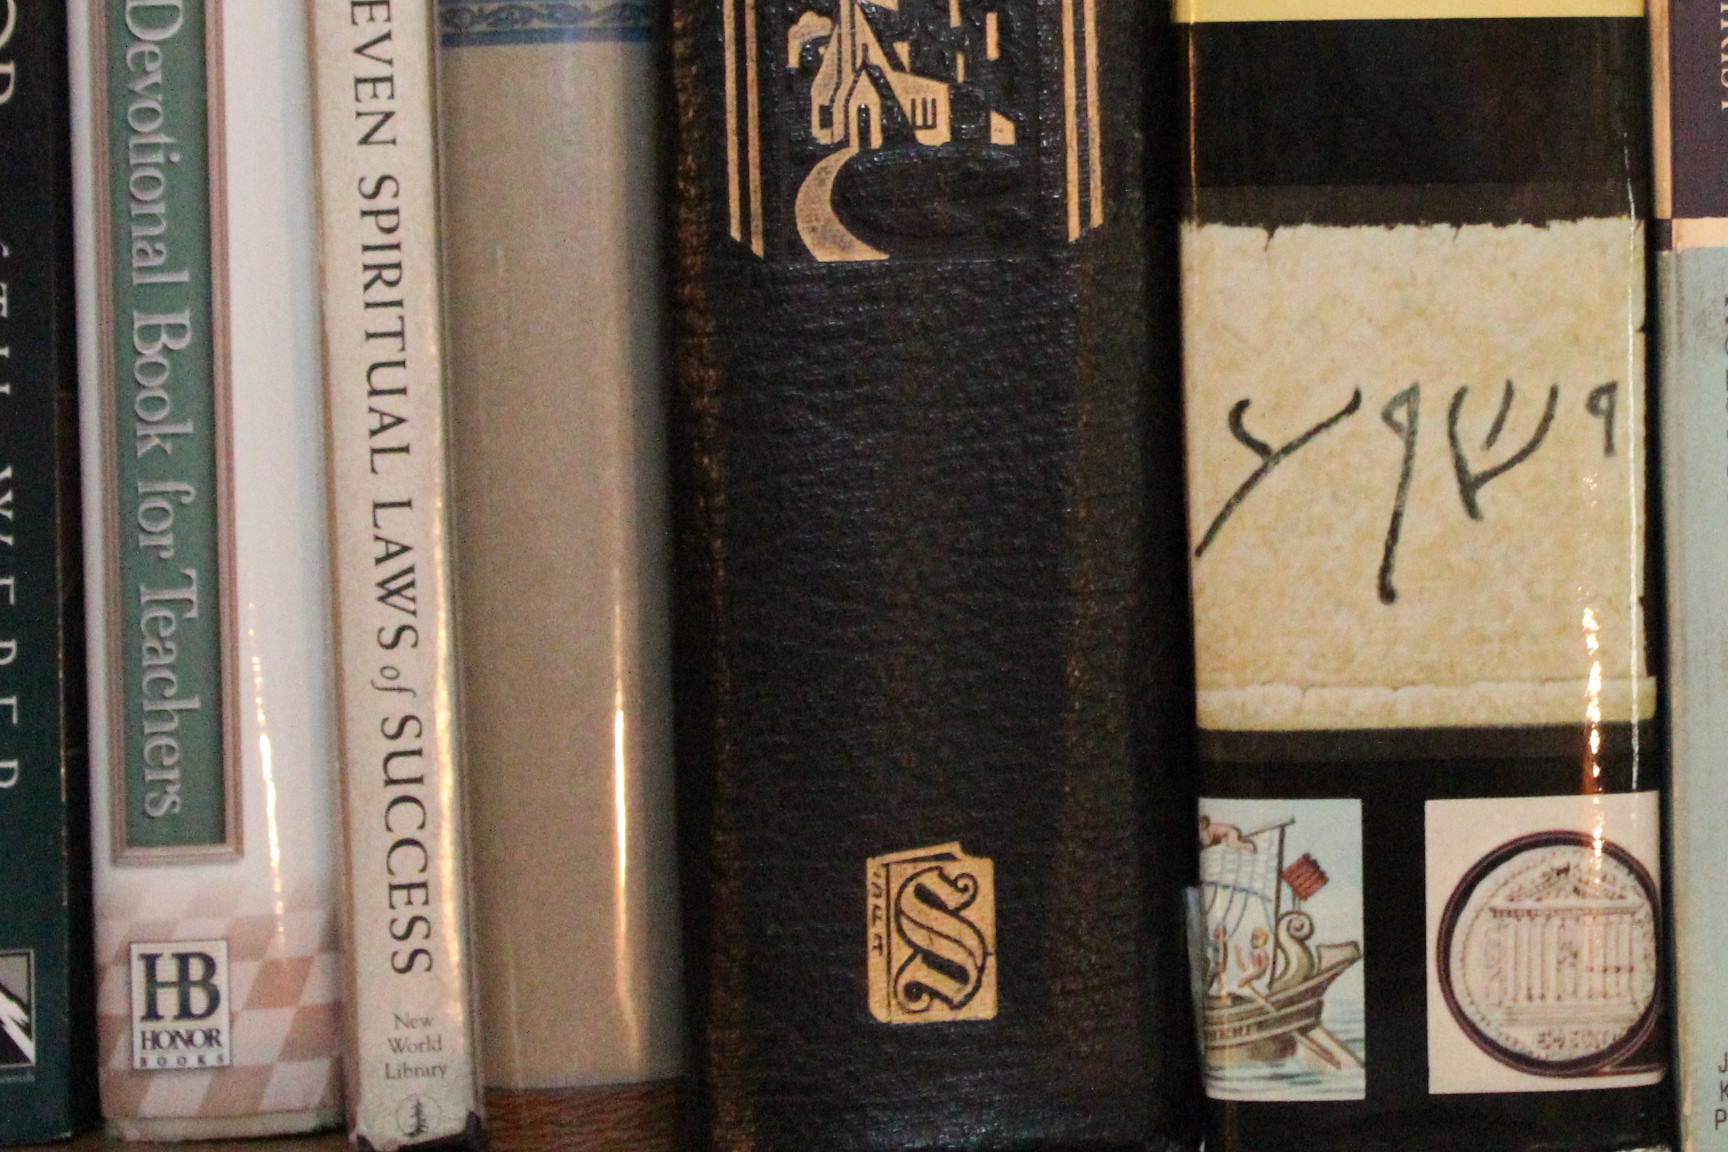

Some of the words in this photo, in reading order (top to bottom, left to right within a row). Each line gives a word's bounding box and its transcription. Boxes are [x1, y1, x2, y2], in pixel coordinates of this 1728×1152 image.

[358, 173, 411, 475] SPIRITUAL
[133, 309, 194, 456] Book
[137, 482, 196, 557] for
[371, 497, 420, 650] LAWS
[138, 570, 200, 818] Teachers
[370, 666, 410, 699] of
[380, 713, 433, 976] SUCCESS
[139, 951, 222, 1022] HB
[141, 1029, 222, 1051] HONOR
[388, 1033, 442, 1055] World
[393, 1013, 435, 1032] New
[138, 1052, 226, 1068] BOOKS
[384, 1059, 447, 1084] Library
